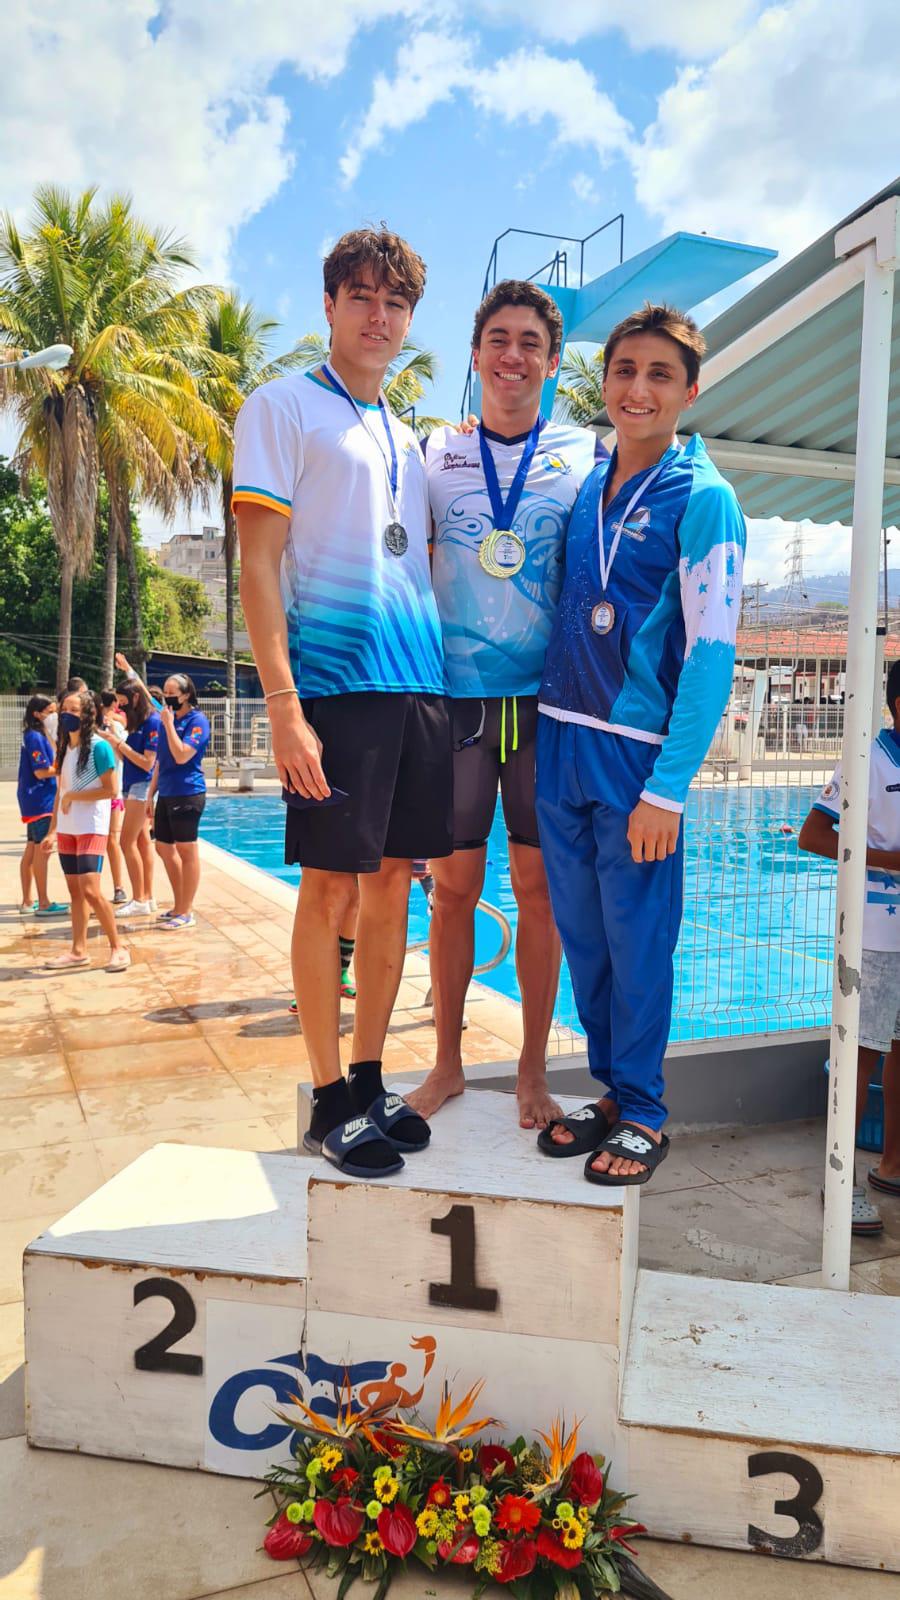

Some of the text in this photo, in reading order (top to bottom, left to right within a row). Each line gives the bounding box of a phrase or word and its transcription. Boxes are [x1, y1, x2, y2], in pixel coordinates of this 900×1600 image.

[345, 1117, 369, 1136] NIKE
[428, 1204, 499, 1312] 1
[133, 1277, 203, 1376] 2
[747, 1451, 825, 1558] 3
